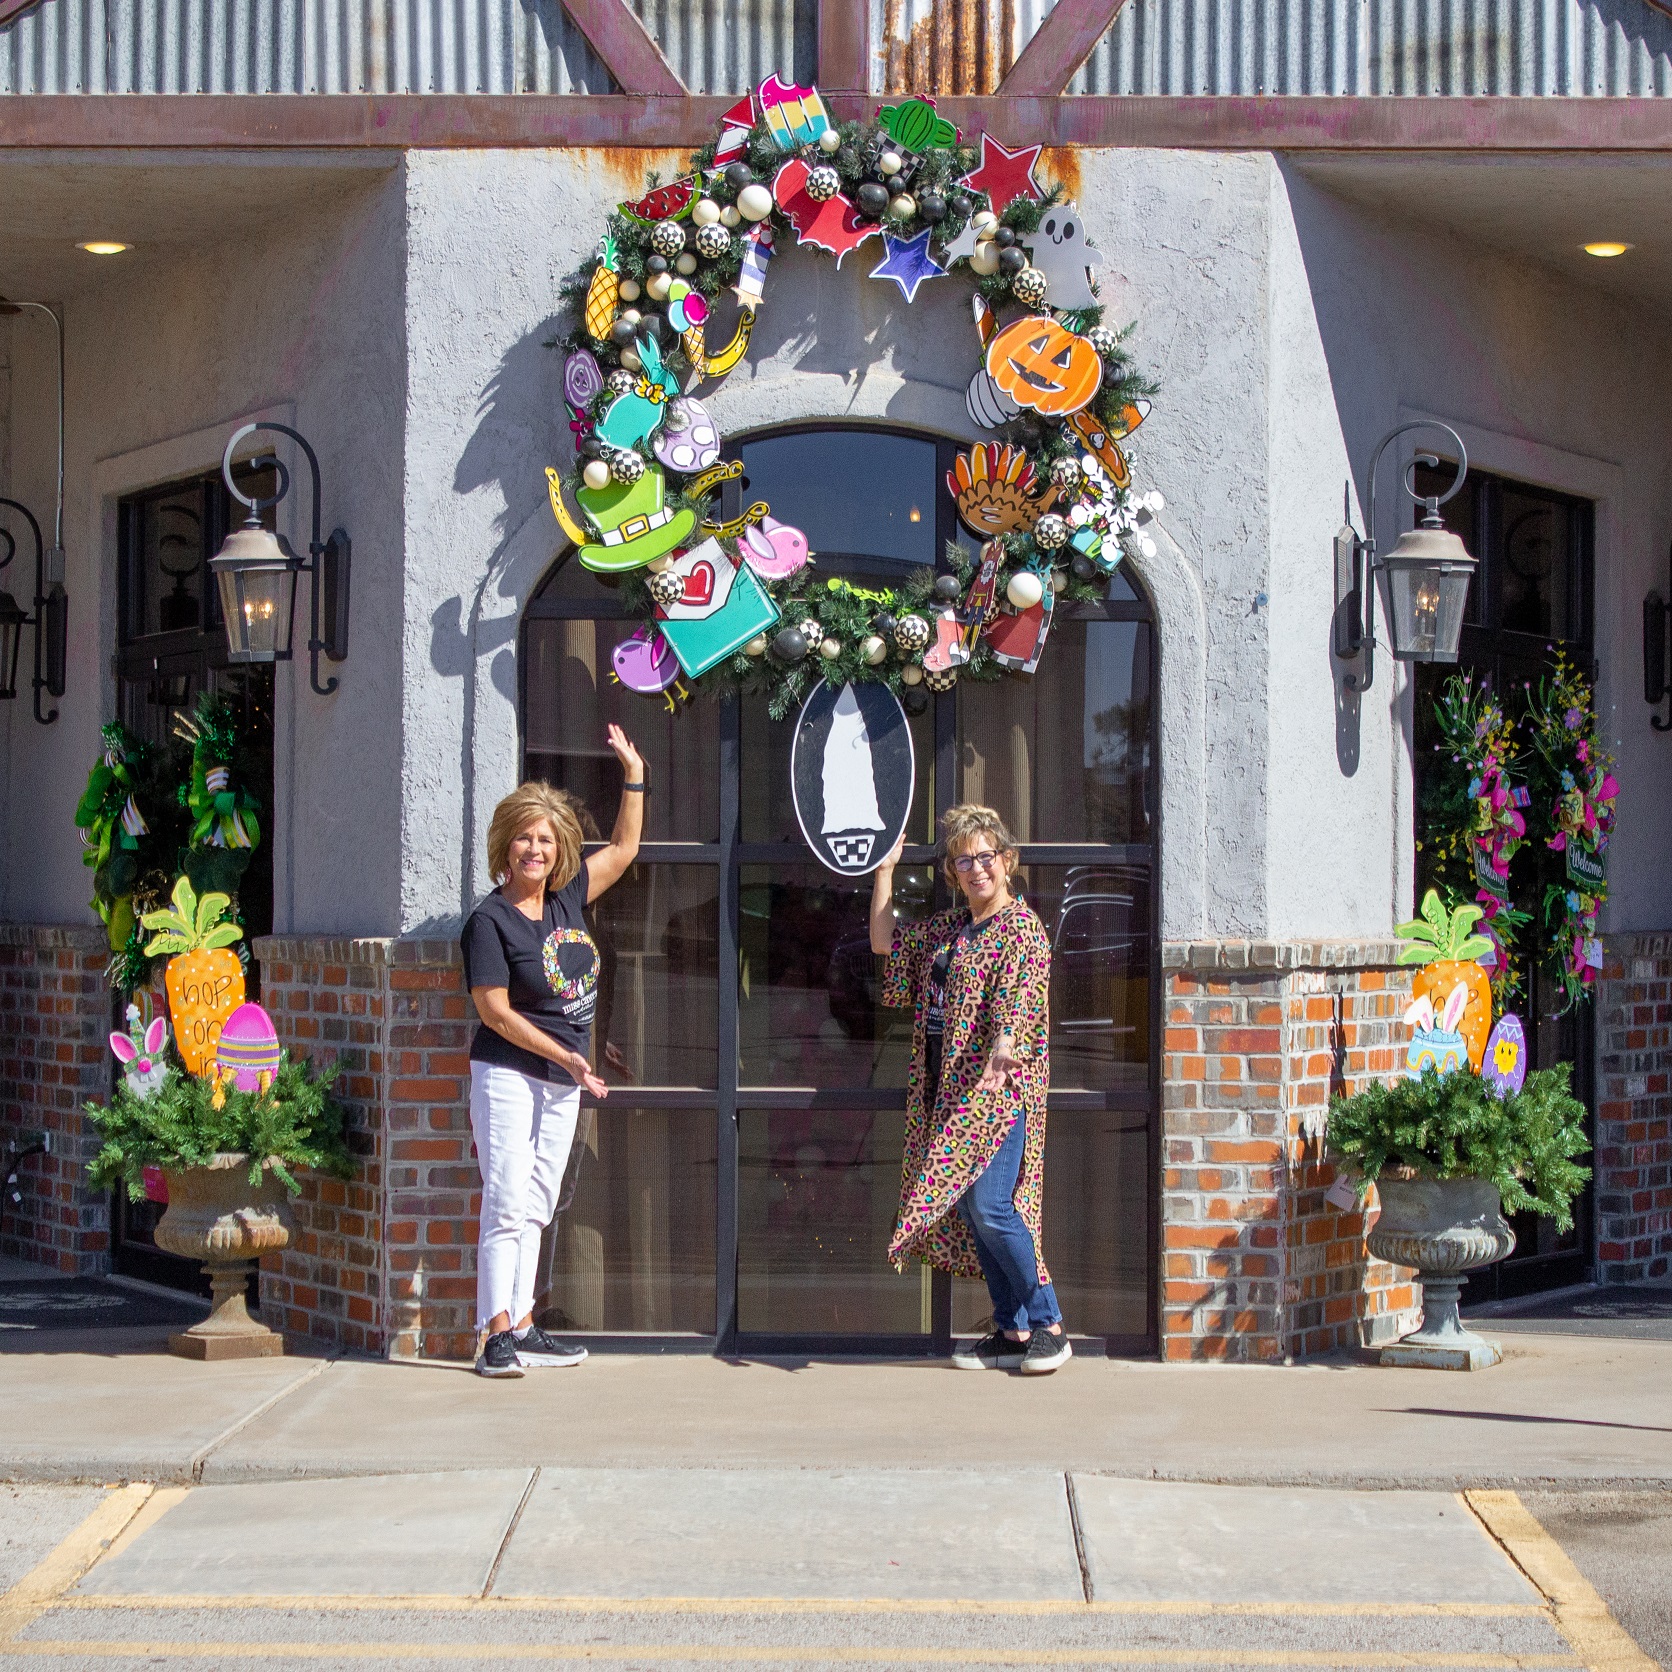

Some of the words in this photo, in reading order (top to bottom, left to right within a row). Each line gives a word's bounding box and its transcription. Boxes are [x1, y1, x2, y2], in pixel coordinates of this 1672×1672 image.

[1569, 844, 1603, 878] Welcome
[182, 975, 232, 1008] hop
[193, 1020, 223, 1046] on
